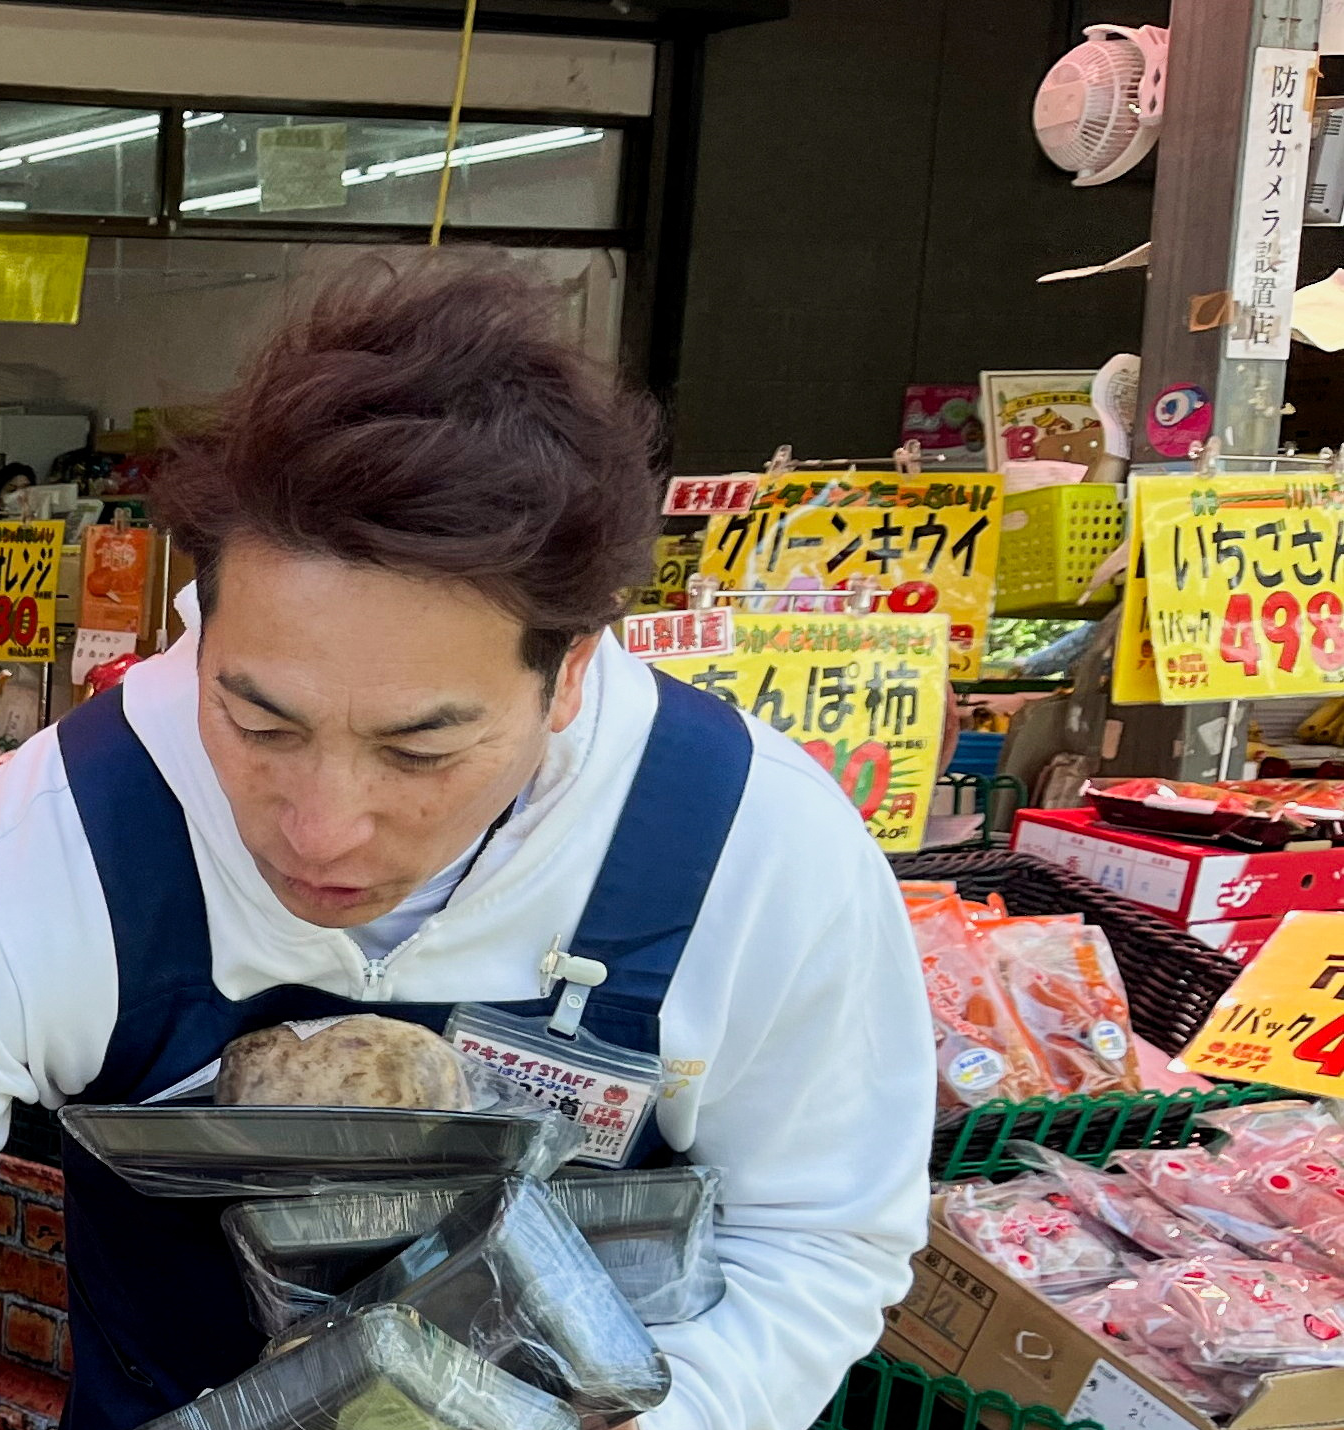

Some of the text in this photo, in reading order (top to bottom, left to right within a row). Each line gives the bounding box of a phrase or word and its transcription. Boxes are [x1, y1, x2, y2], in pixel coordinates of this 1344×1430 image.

[1249, 65, 1298, 345] 防犯カメラ設置店
[718, 511, 989, 576] グリーンキウイ
[627, 615, 723, 653] 山梨県産
[1220, 591, 1344, 677] 498
[692, 662, 920, 736] あんぽ柿
[888, 792, 917, 821] 円
[1219, 1004, 1316, 1043] 1パック
[1195, 1053, 1268, 1074] アキダイ
